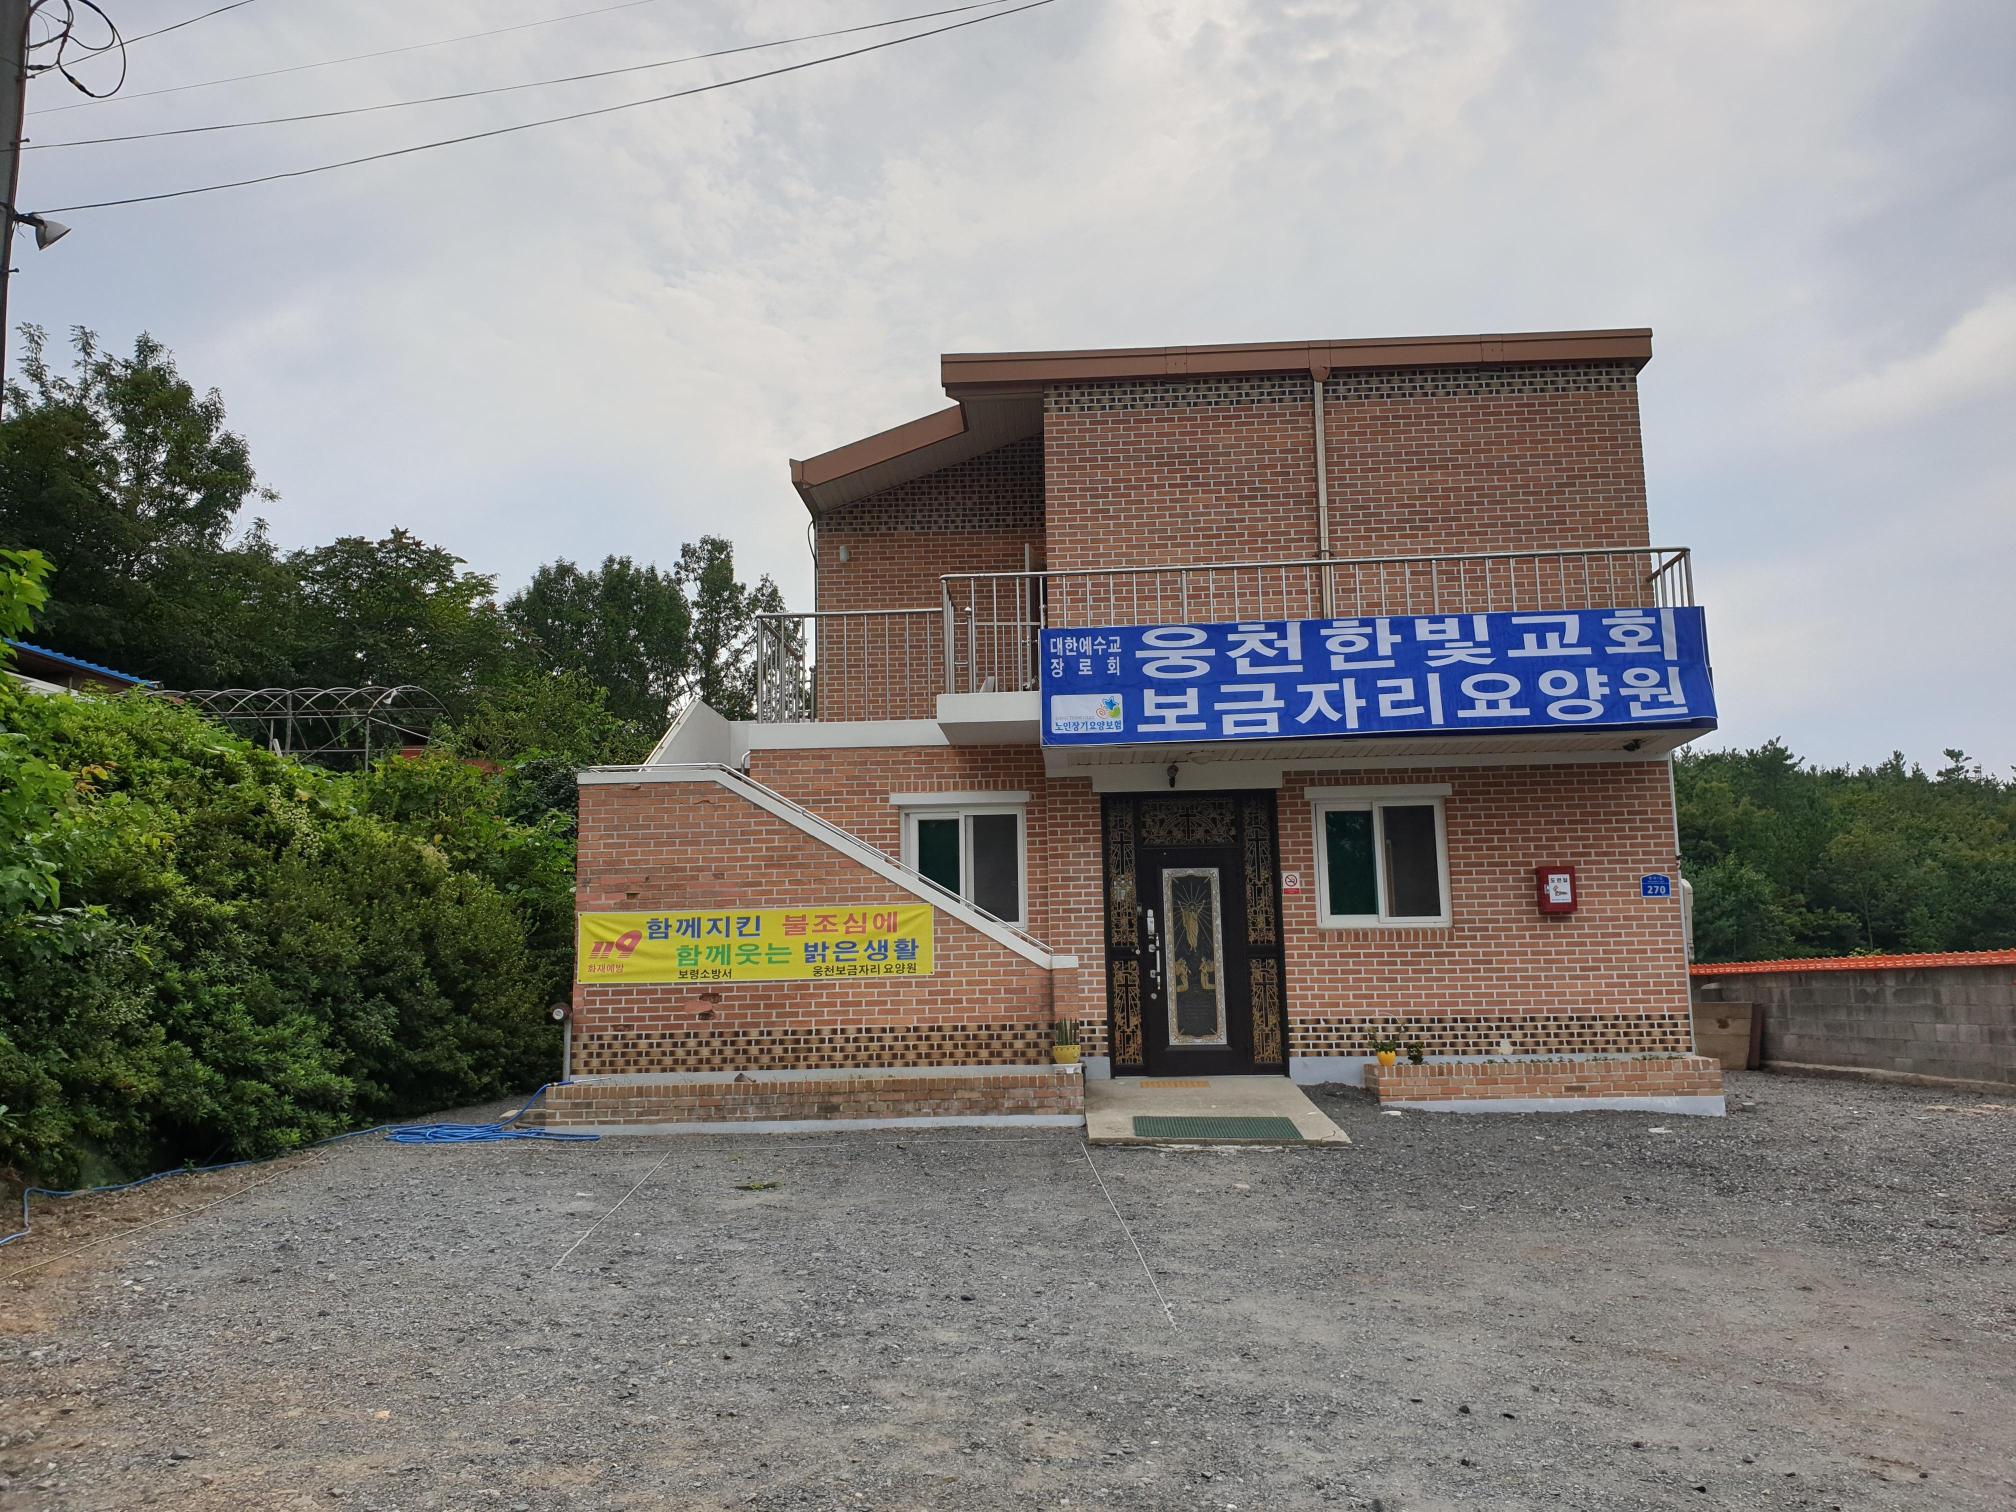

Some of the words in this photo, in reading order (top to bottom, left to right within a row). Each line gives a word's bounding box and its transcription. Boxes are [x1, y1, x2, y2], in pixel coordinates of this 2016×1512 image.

[1049, 636, 1122, 656] 대한예수교
[1134, 608, 1673, 678] 웅천한빛교회
[1137, 667, 1686, 734] 보금자리요양원
[1055, 720, 1122, 732] 노인장기요양보험
[1647, 885, 1666, 894] 270
[646, 915, 761, 940] 함께지킨
[782, 911, 898, 937] 불조심에
[588, 929, 643, 960] 119
[676, 942, 793, 967] 함께웃는
[803, 937, 919, 964] 밝은생활
[587, 963, 624, 973] 화재예방
[678, 968, 732, 980] 보령소방서
